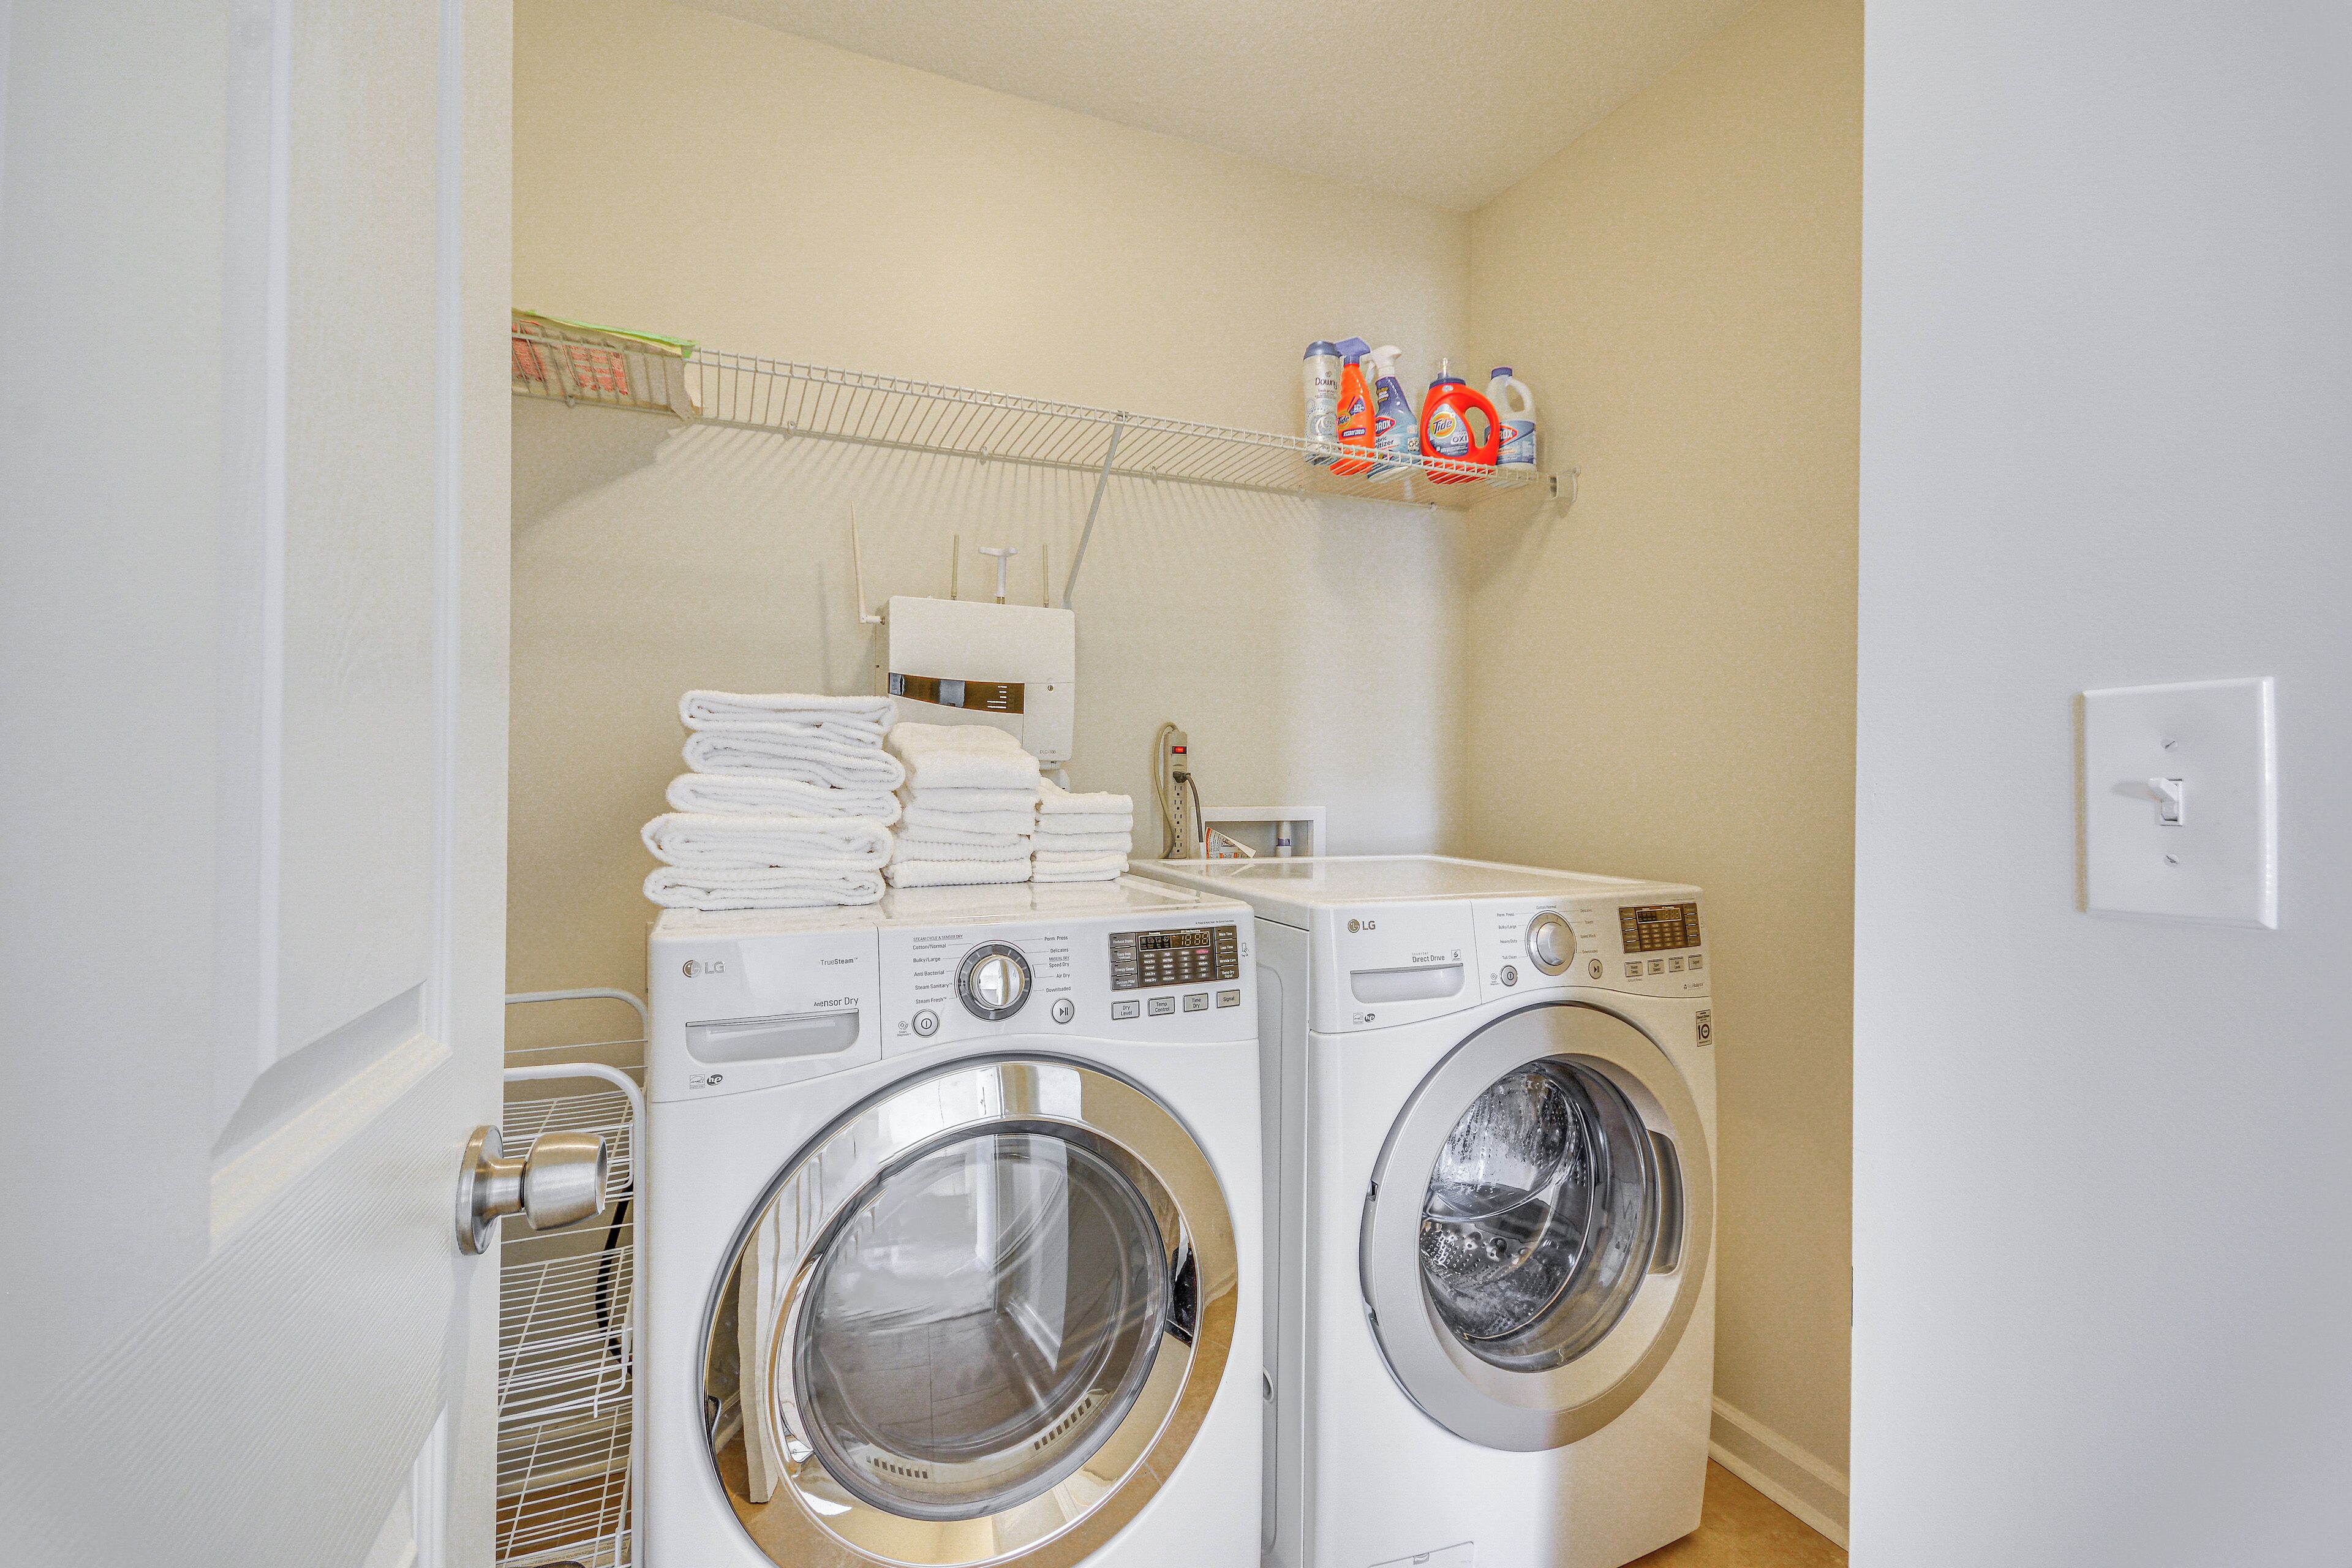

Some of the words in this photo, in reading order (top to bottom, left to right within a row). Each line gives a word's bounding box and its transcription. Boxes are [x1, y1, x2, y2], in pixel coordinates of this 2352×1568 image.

[1315, 377, 1338, 390] Downy
[1337, 416, 1349, 426] Tide
[1433, 418, 1452, 435] Tide
[1362, 921, 1376, 930] LG
[705, 961, 726, 974] LG
[845, 997, 859, 1006] Dry
[1698, 1023, 1710, 1040] 10
